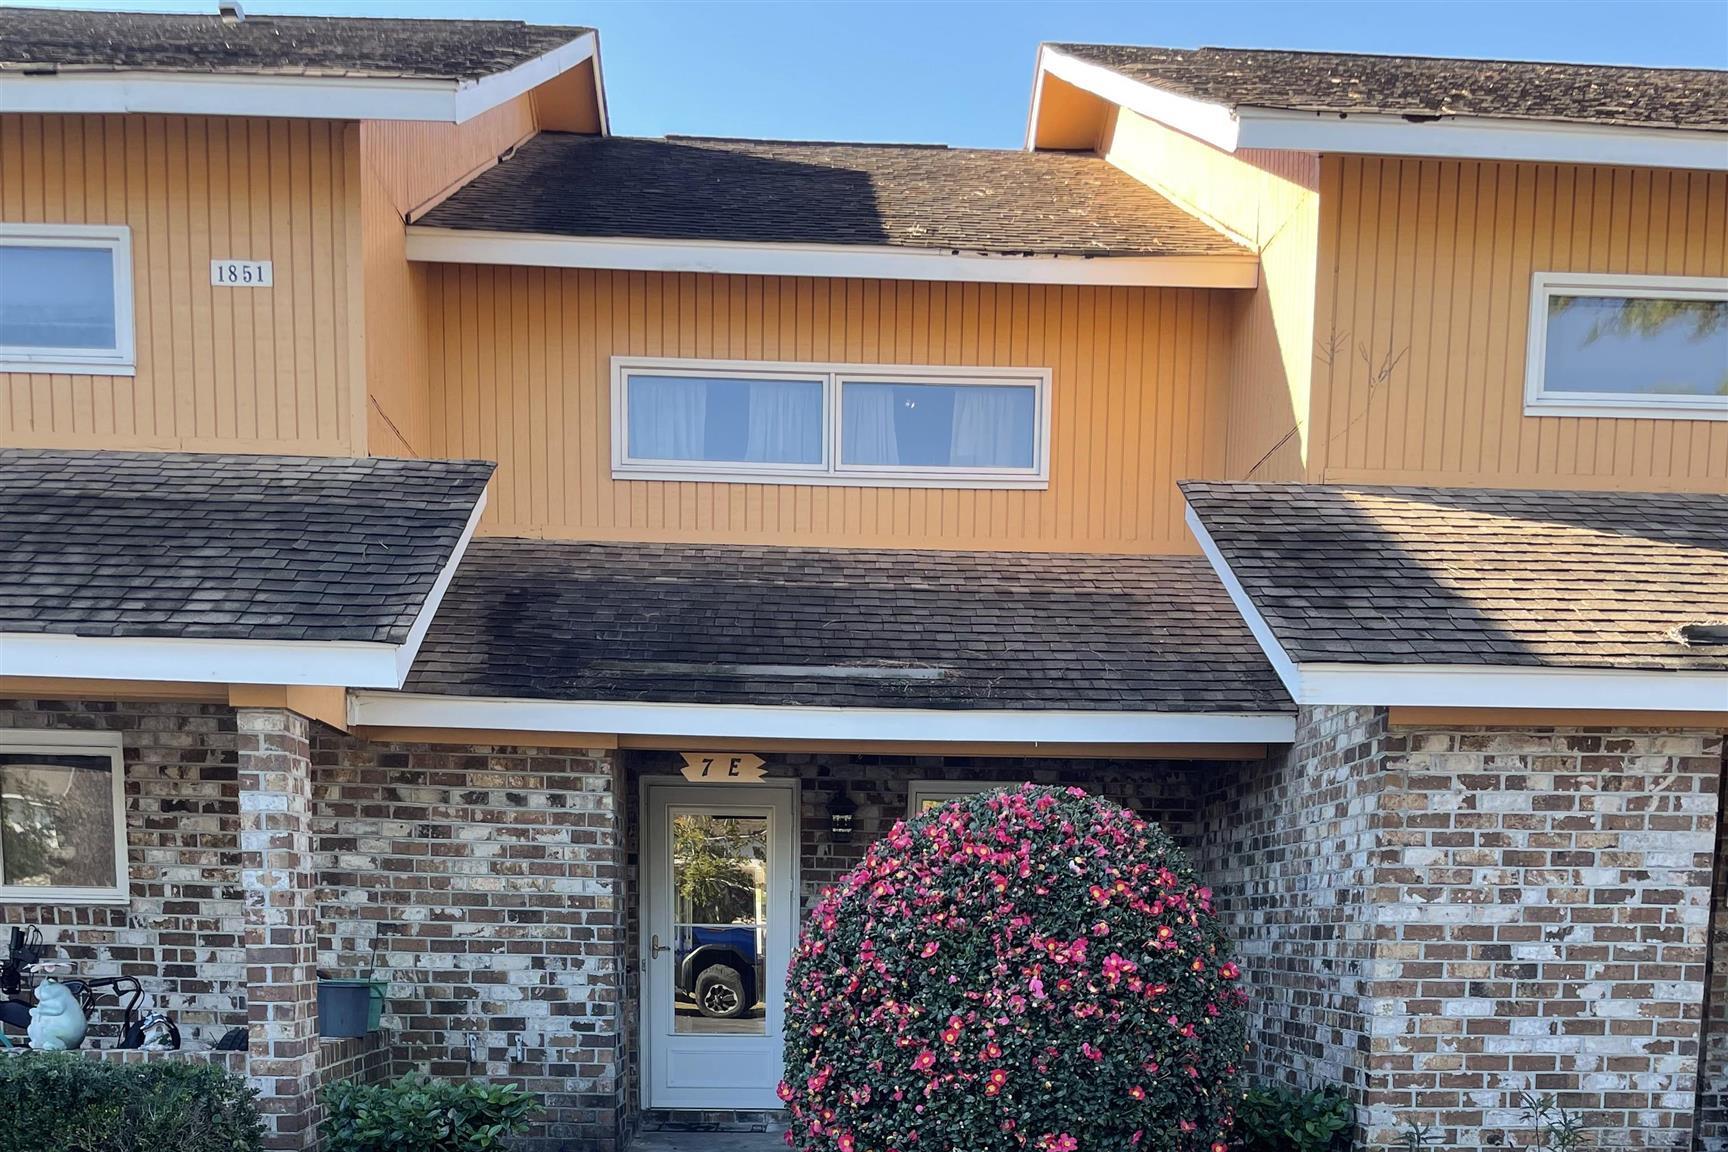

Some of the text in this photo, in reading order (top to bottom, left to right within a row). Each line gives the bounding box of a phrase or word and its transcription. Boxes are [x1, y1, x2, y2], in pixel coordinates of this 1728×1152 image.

[218, 264, 263, 283] 1851
[702, 757, 742, 777] 7 E
